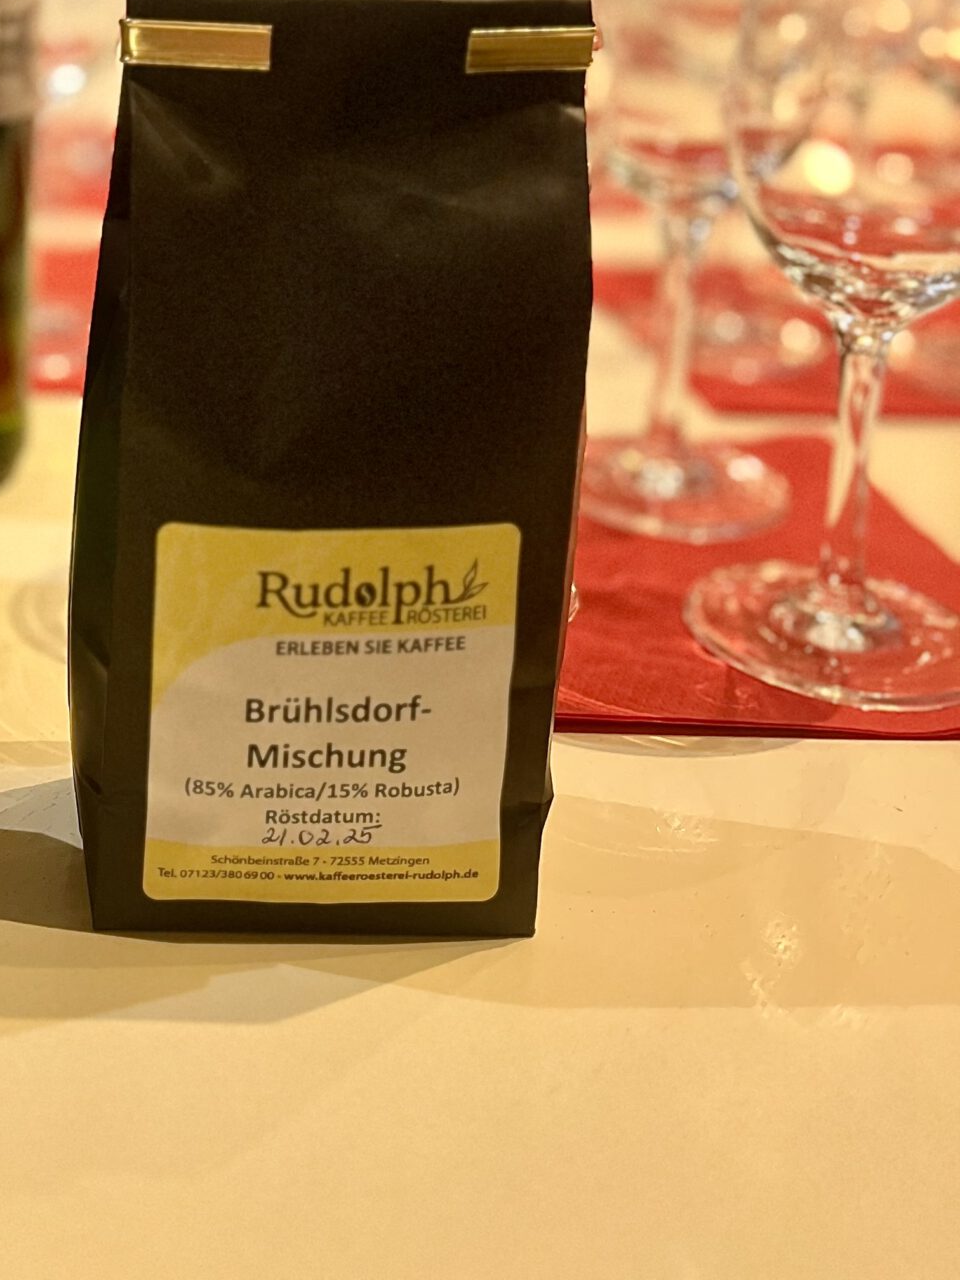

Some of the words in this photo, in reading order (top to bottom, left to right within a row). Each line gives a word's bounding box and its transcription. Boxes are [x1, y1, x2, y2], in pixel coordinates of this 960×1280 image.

[256, 564, 453, 625] Rudolph
[323, 610, 388, 627] KAFFEE
[406, 602, 487, 624] RÖSTEREI
[276, 640, 359, 656] ERLEBEN
[364, 639, 393, 655] SIE
[397, 636, 466, 653] KAFFEE
[245, 695, 432, 723] Brühlsdorf-
[247, 742, 408, 774] Mischung
[185, 777, 234, 798] (85%
[240, 782, 368, 801] Arabica/15%
[374, 777, 460, 798] Robusta)
[265, 809, 381, 824] Röstdatum:
[261, 824, 383, 846] 21.02.25
[211, 854, 310, 866] Schönbeinstraße
[313, 856, 320, 866] 7
[330, 856, 365, 866] 72555
[368, 855, 430, 867] Metzingen
[284, 869, 479, 881] www.kaffeeroesterei-rudolph.de
